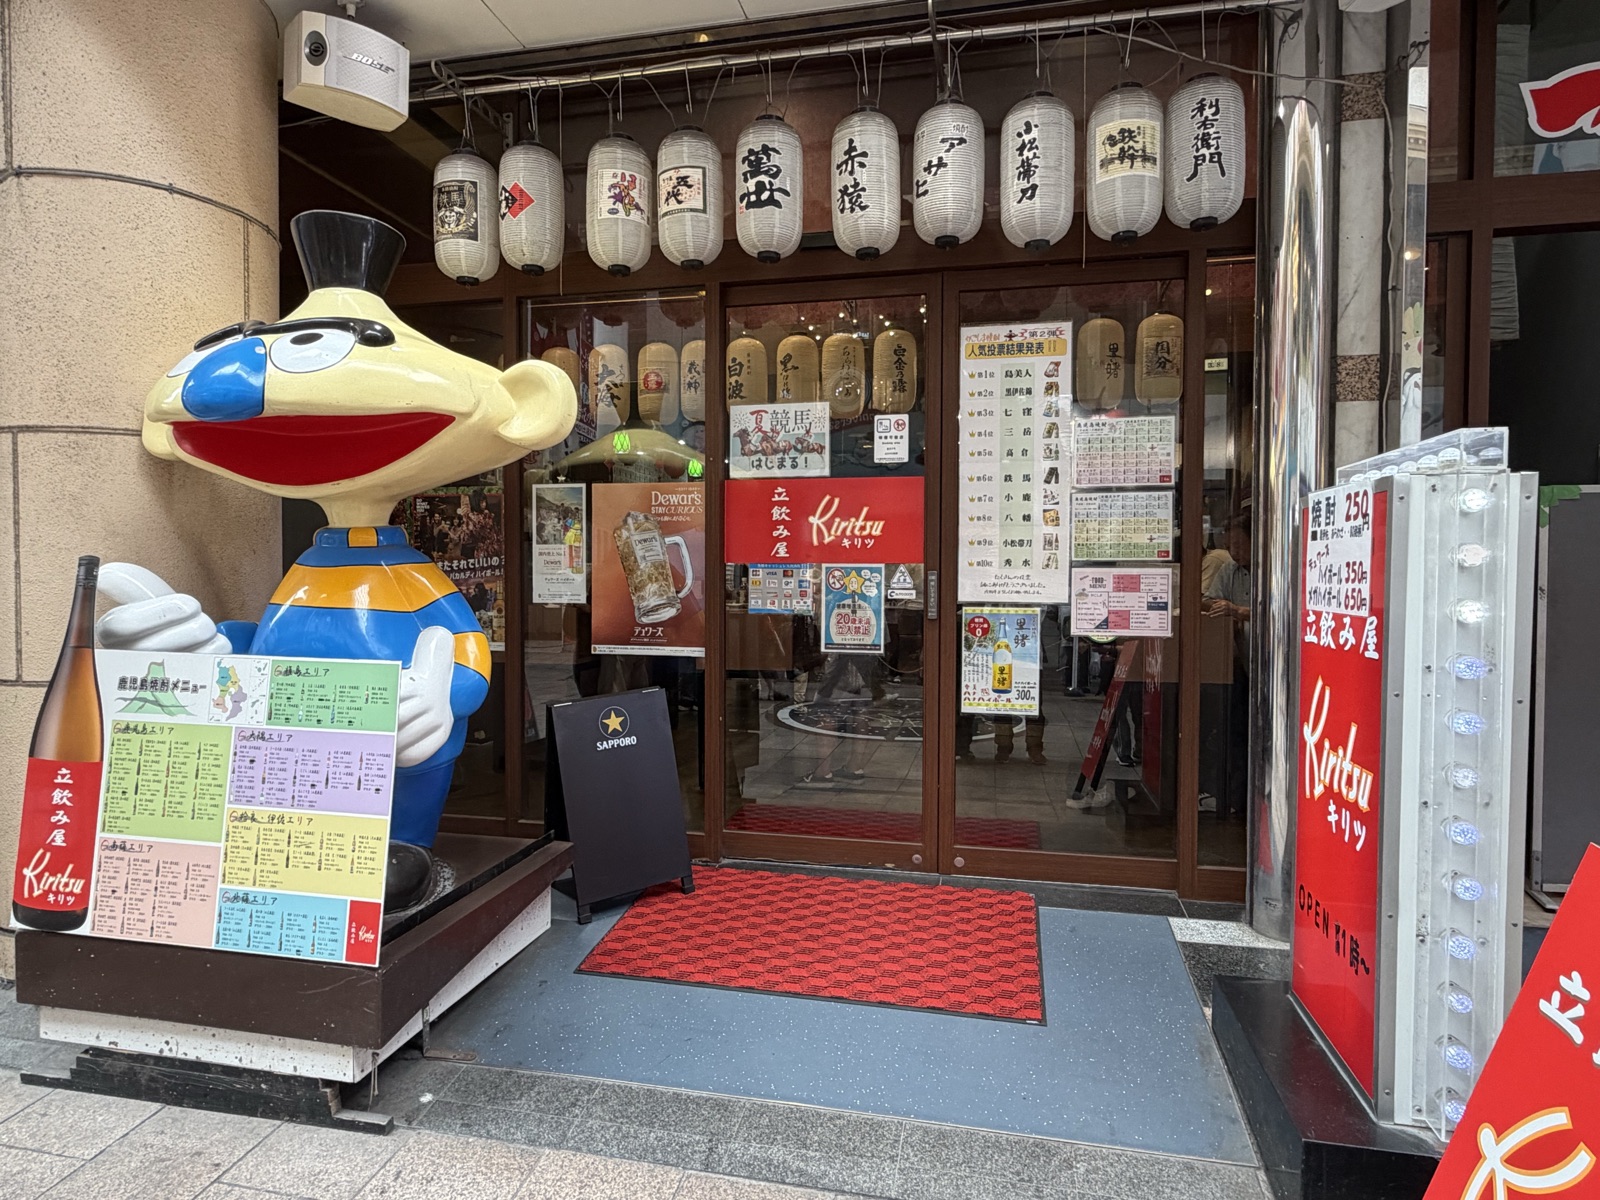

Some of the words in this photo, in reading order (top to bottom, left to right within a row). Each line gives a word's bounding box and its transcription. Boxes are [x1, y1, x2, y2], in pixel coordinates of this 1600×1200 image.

[1185, 97, 1226, 182] 利右衛門
[836, 139, 870, 214] 赤猿
[915, 136, 968, 199] アサヒ
[1016, 121, 1040, 204] 小松帯刀
[664, 175, 694, 206] 五代
[728, 357, 747, 400] 白波
[749, 409, 813, 434] 夏競馬
[651, 490, 702, 505] Dewar's
[651, 506, 666, 514] STAY
[1311, 496, 1336, 528] 焼酎
[771, 487, 791, 558] 立飲み屋
[808, 494, 885, 547] Kiritsu
[841, 538, 874, 549] キリツ
[1318, 564, 1342, 585] ハイボール
[1344, 560, 1367, 585] 350円
[1308, 586, 1342, 609] メガハイボール
[1344, 587, 1367, 611] 650円
[633, 626, 664, 637] デュワーズ
[837, 625, 871, 635] 立入禁止
[975, 628, 982, 637] 0
[1304, 611, 1379, 660] 立飲み屋
[117, 676, 208, 693] 鹿児島焼酎メニュー
[1014, 689, 1036, 702] 300円
[596, 735, 637, 751] SAPPORO
[1303, 674, 1374, 813] Kiritsu
[46, 767, 74, 846] 立飲み屋
[1326, 799, 1367, 852] キリツ
[22, 848, 87, 899] Kiritsu
[47, 892, 75, 906] キリツ
[1298, 883, 1330, 940] OPEN
